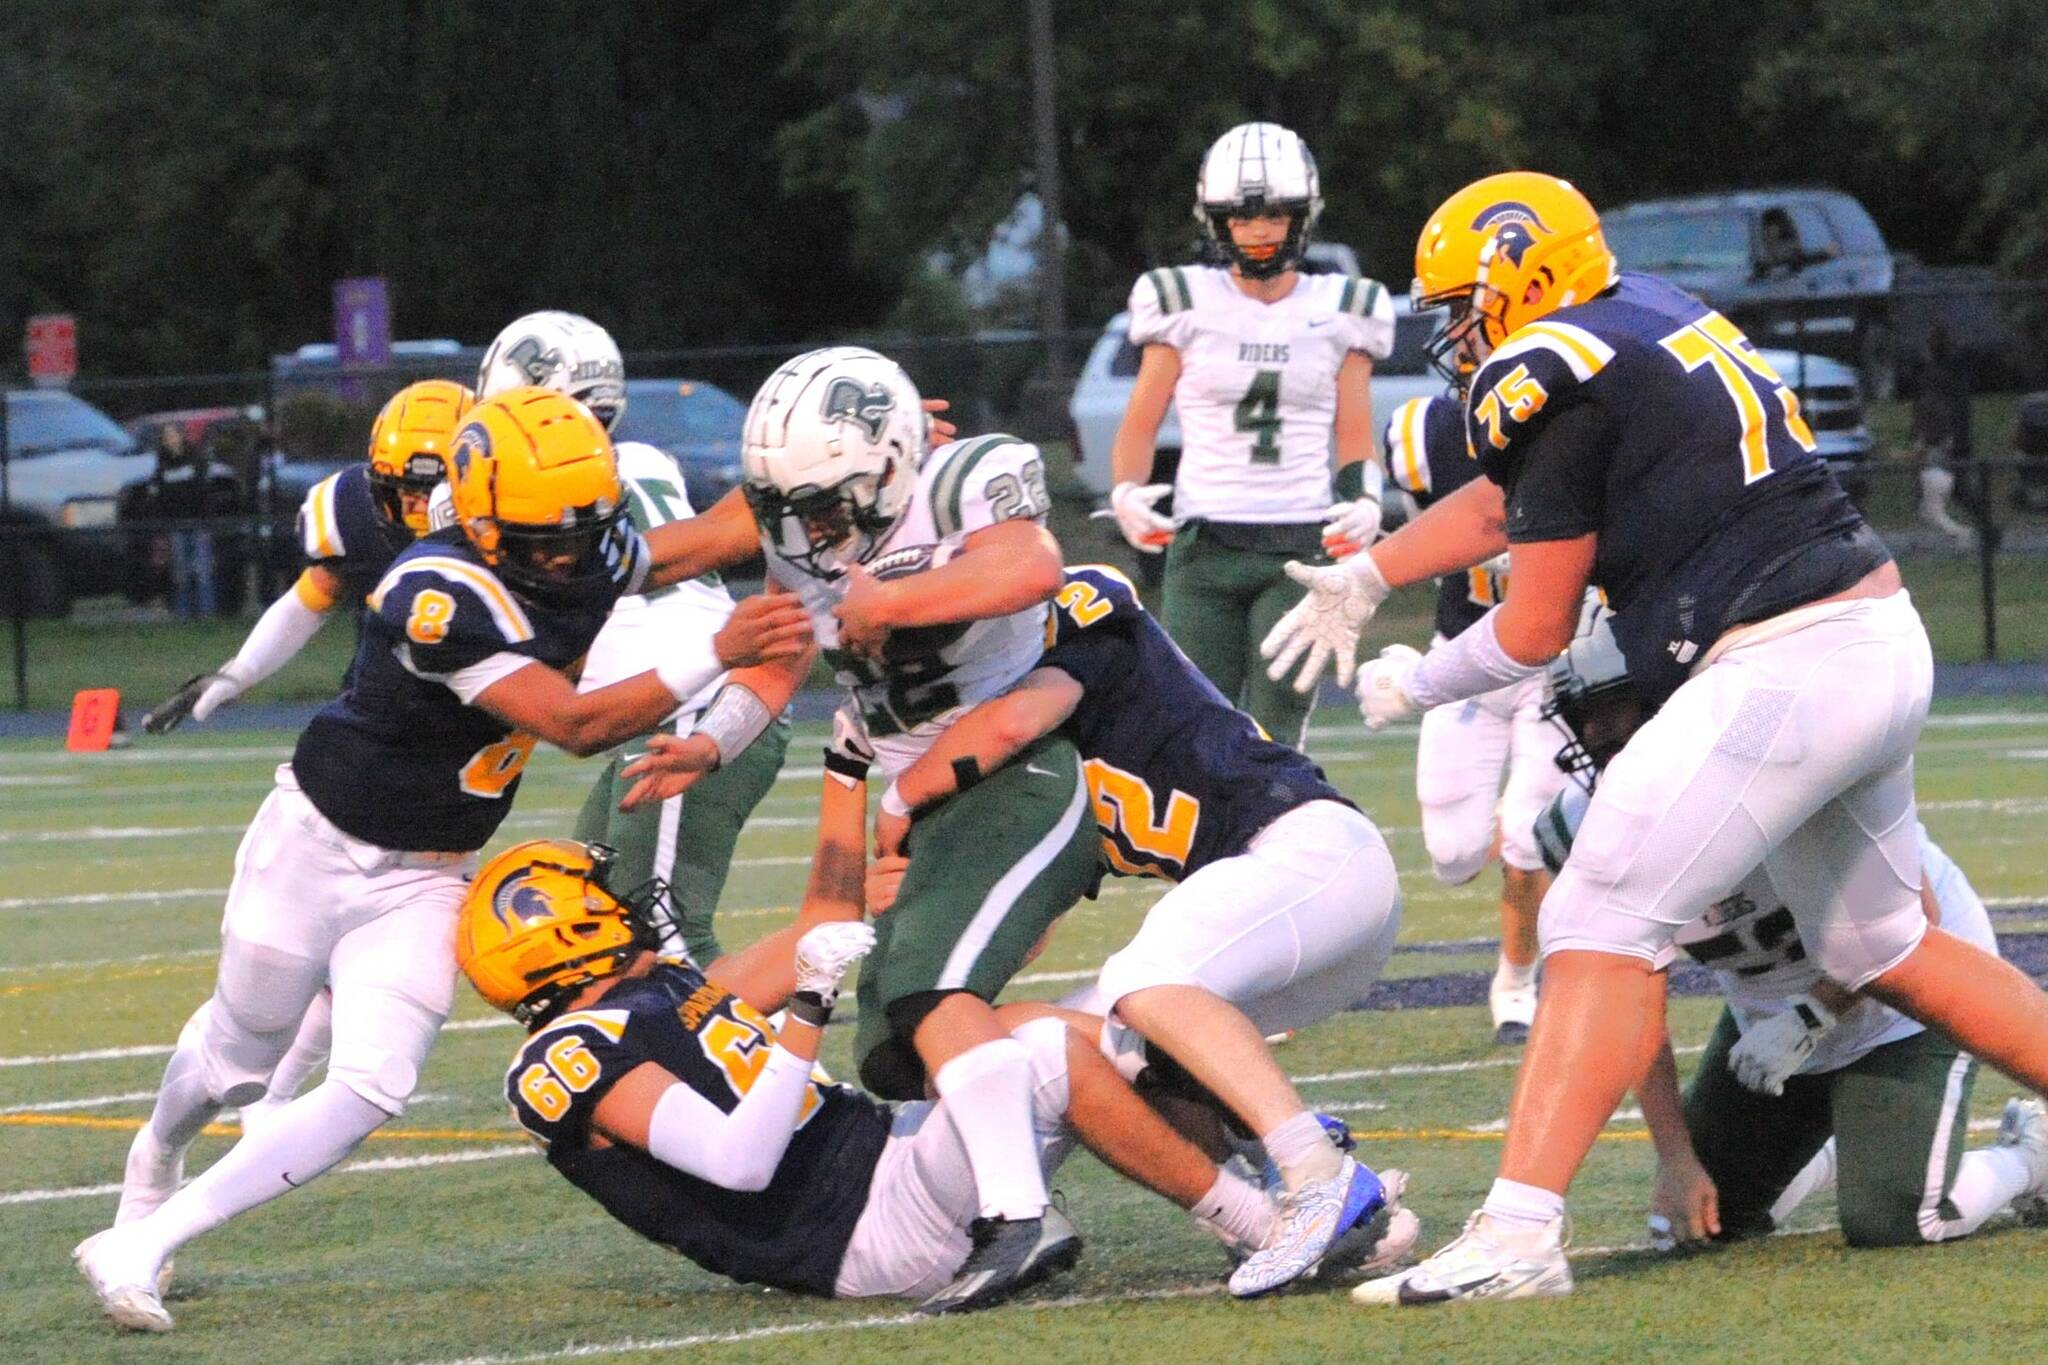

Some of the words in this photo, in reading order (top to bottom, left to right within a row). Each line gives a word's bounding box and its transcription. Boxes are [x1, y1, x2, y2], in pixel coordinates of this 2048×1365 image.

[1237, 344, 1290, 363] RIDERS
[1233, 370, 1283, 464] 4
[1473, 362, 1550, 451] 75
[406, 588, 458, 644] 8
[517, 1034, 602, 1123] 66
